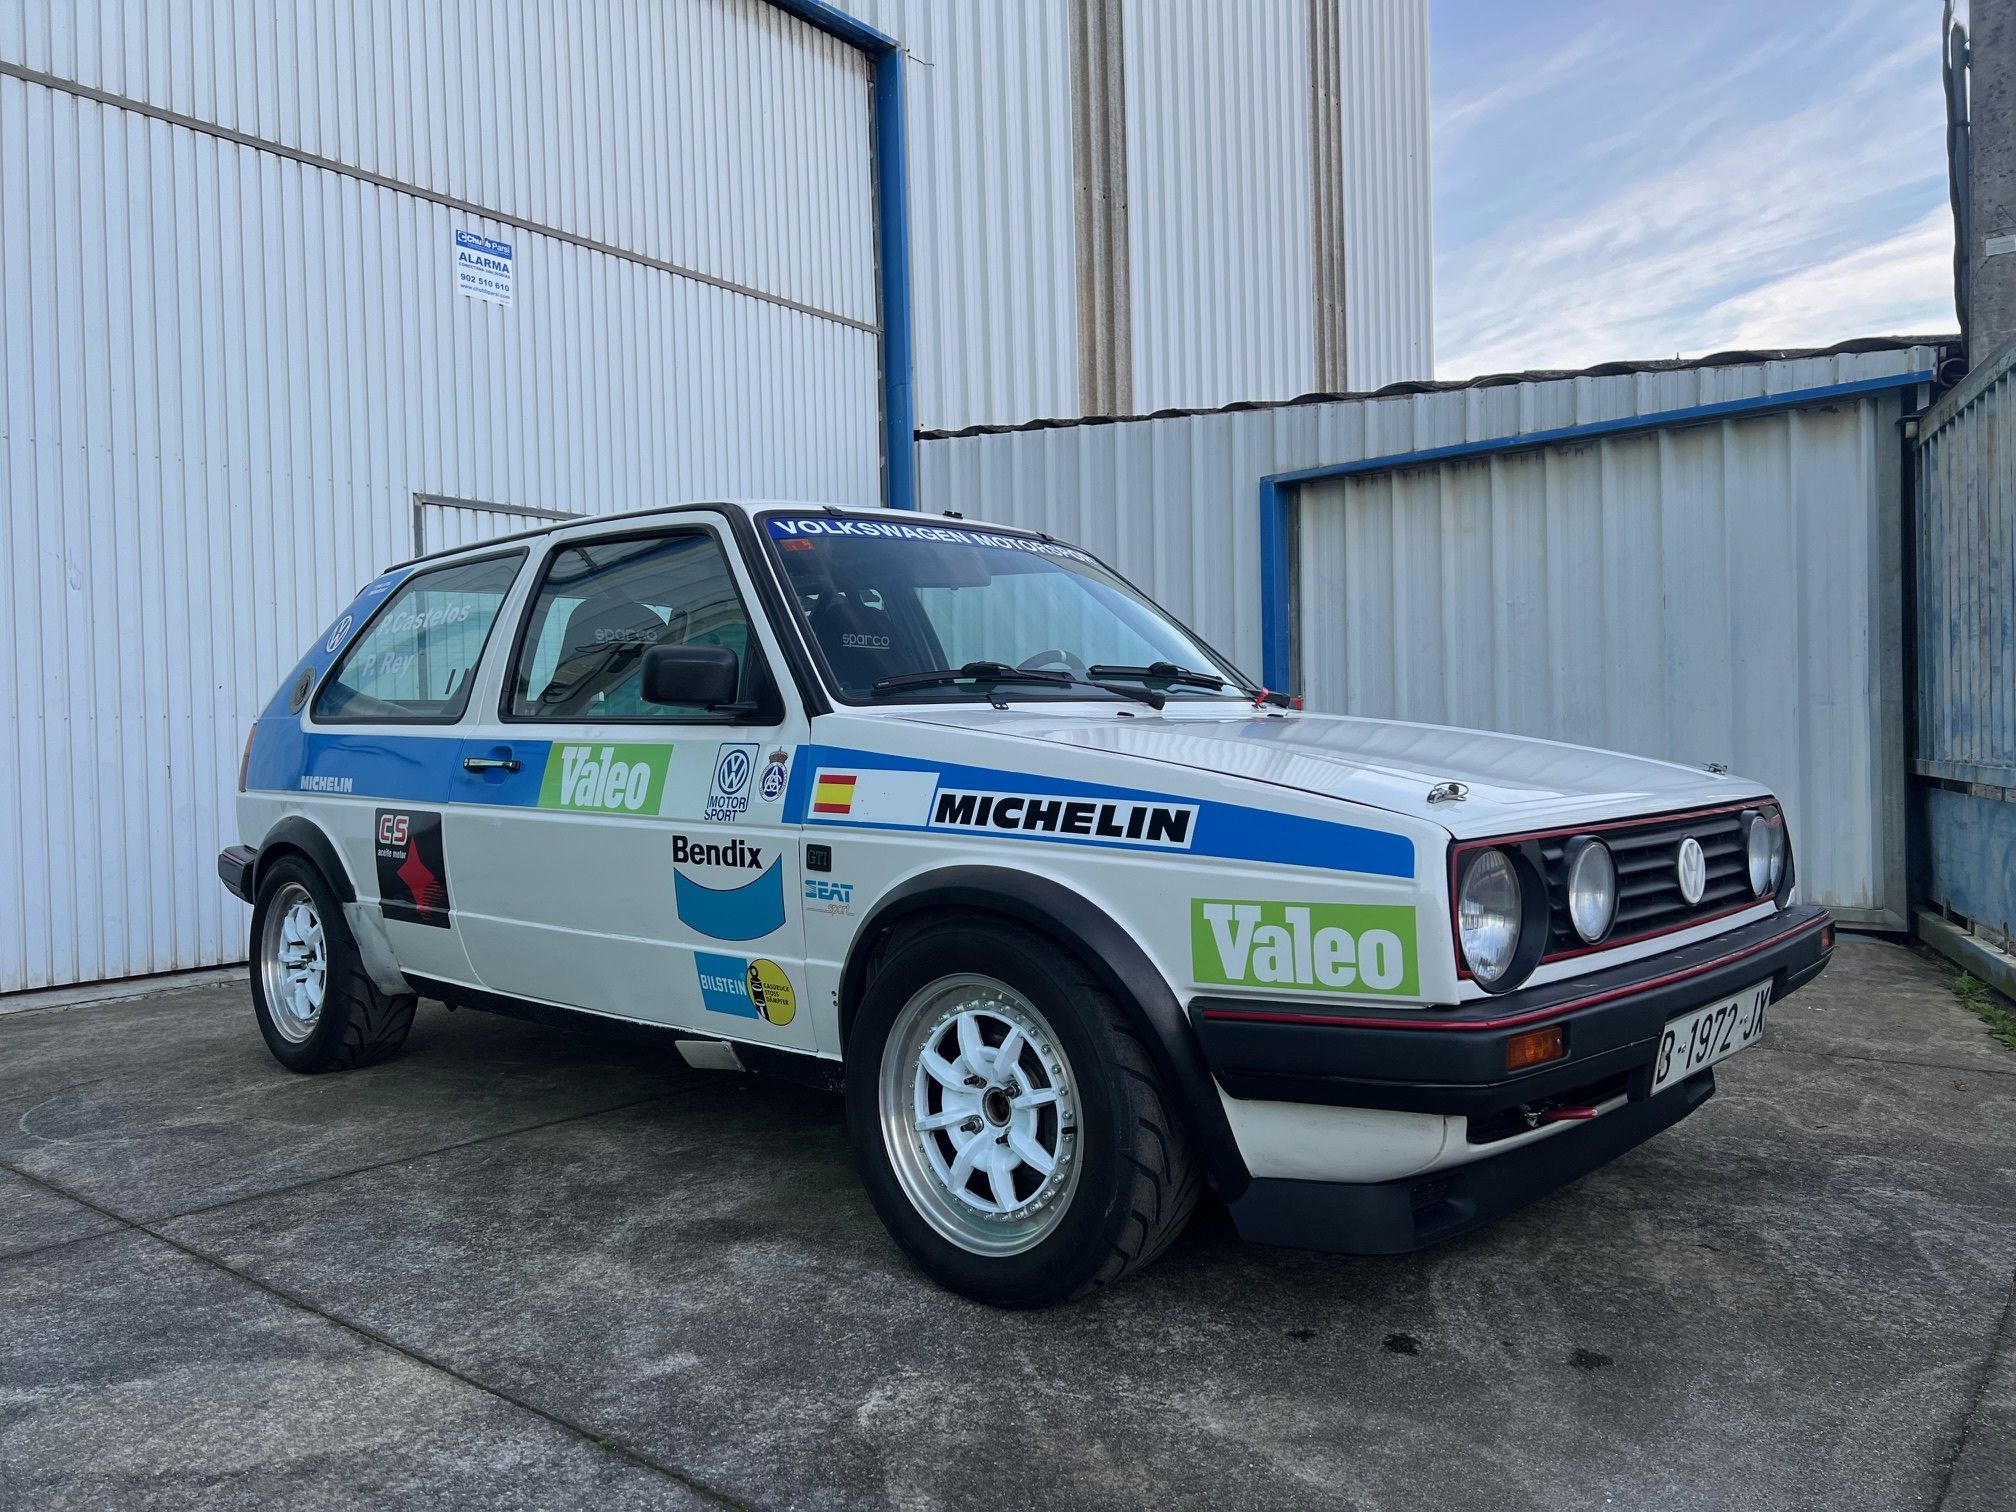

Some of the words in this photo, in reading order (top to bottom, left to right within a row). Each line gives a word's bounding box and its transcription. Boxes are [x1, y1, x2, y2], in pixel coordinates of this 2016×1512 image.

[467, 234, 491, 248] Chub
[459, 252, 510, 273] ALARMA
[460, 273, 476, 283] 902
[478, 277, 493, 287] 510
[495, 282, 510, 292] 610
[774, 520, 972, 544] VOLKSWAGEN
[842, 633, 890, 647] sparco
[300, 776, 353, 793] MICHELIN
[560, 746, 651, 810] Valeo
[709, 795, 747, 809] MOTOR
[704, 809, 738, 822] SPORT
[935, 792, 1191, 843] MICHELIN
[378, 814, 410, 846] CS
[393, 850, 407, 859] motor
[673, 835, 763, 870] Bendix
[807, 849, 828, 866] GTI
[805, 879, 854, 903] SEAT
[1203, 903, 1404, 990] Valeo
[700, 973, 747, 997] BILSTEIN
